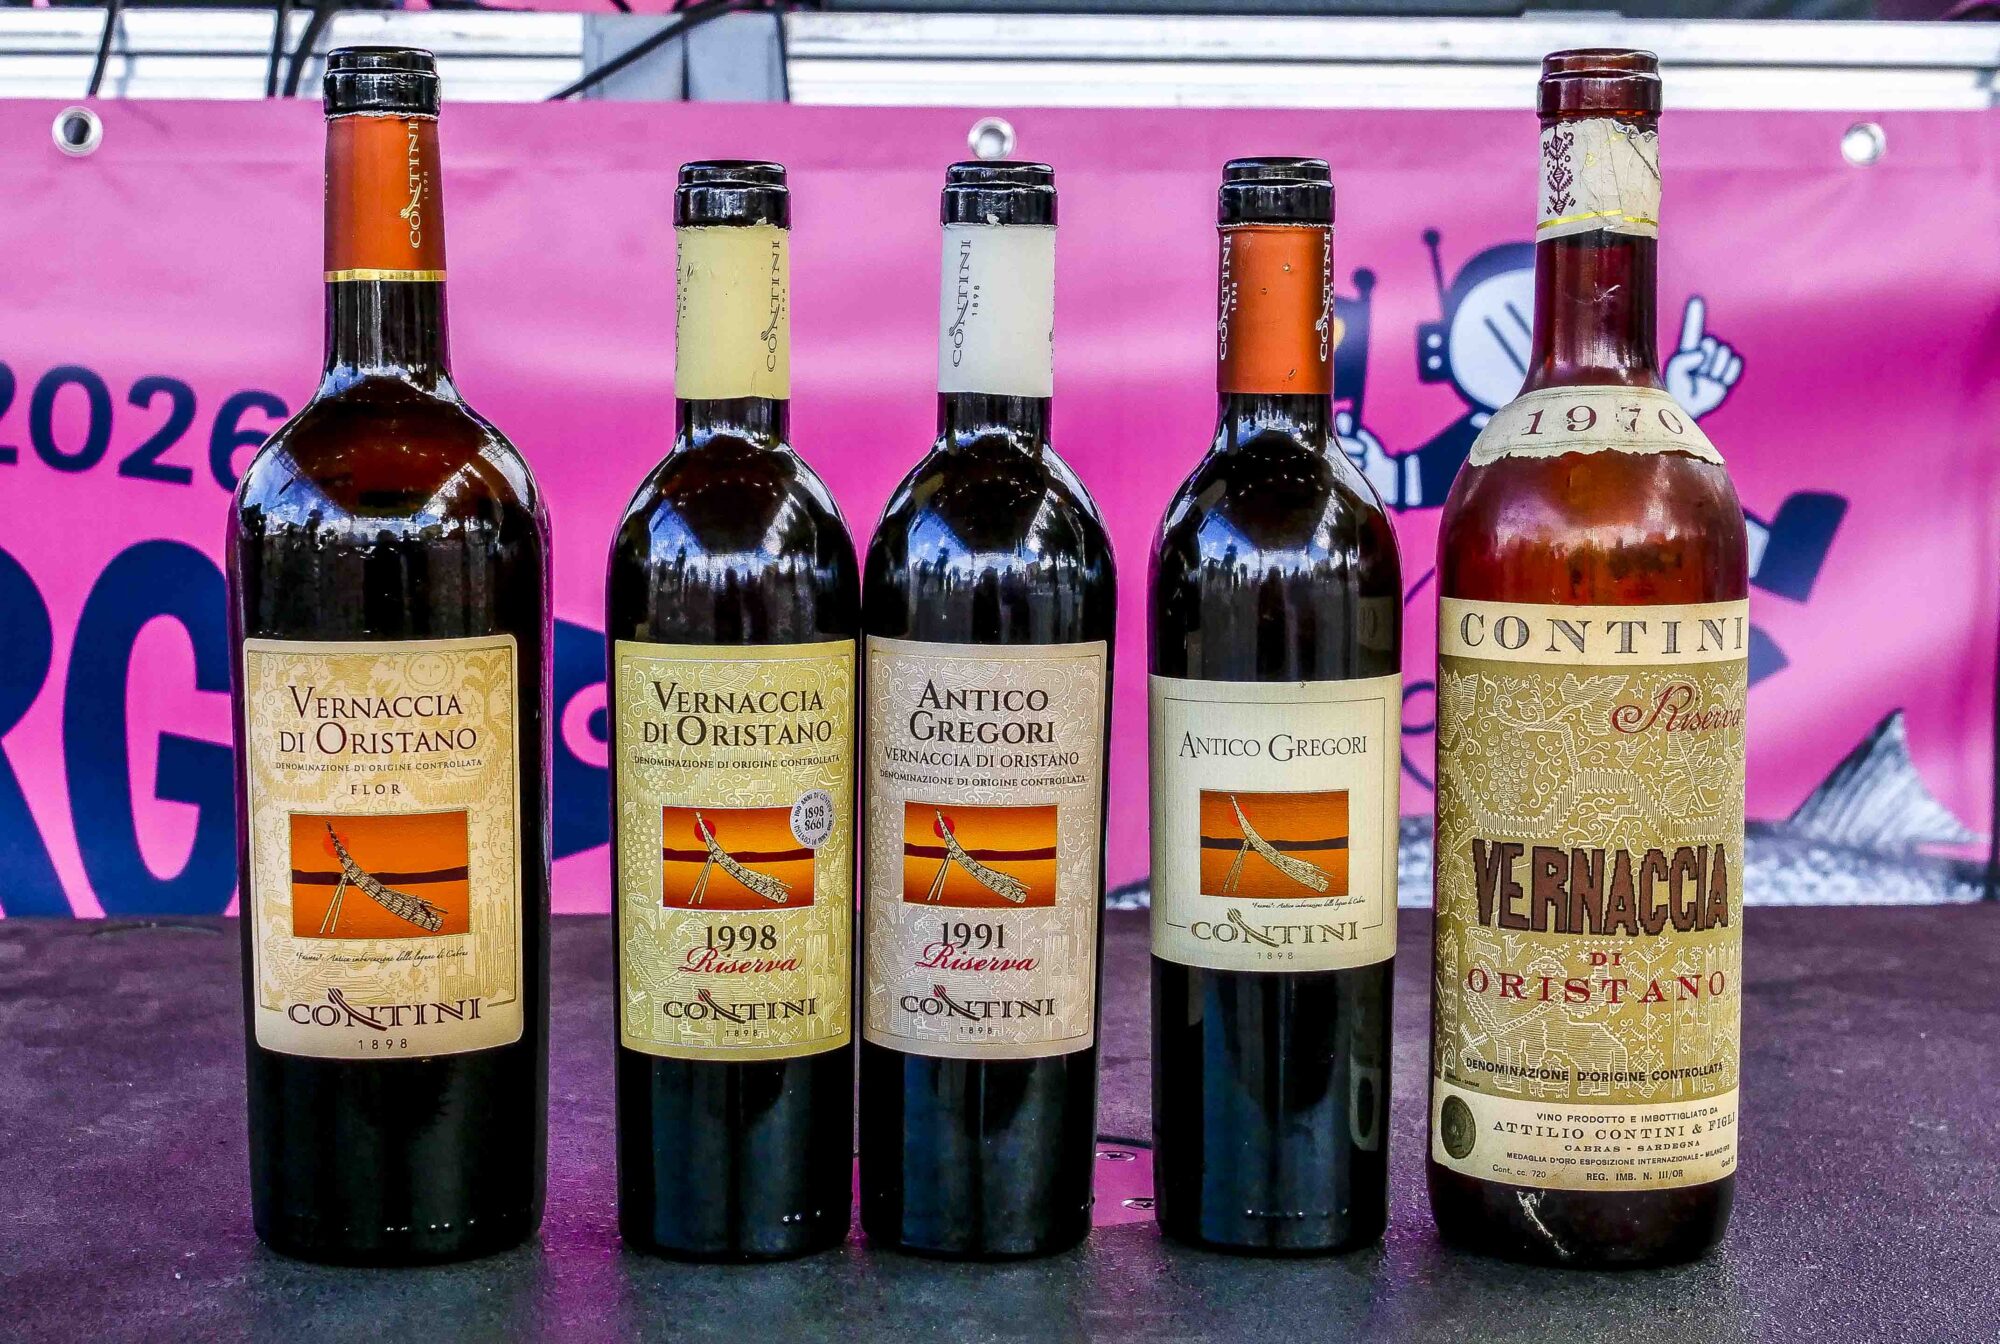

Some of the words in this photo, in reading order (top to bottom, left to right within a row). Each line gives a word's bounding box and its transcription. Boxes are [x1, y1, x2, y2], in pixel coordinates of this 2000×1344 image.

[400, 122, 421, 248] CONTINI
[761, 240, 780, 372] CONTINI
[949, 240, 971, 367] CONTINI
[971, 285, 980, 316] 1898
[1218, 235, 1232, 360] CONTINI
[1316, 232, 1331, 362] CONTINI
[0, 366, 290, 498] 026
[1521, 405, 1684, 436] 1970
[1460, 612, 1744, 654] CONTINI
[288, 685, 464, 719] VERNACCIA
[651, 681, 825, 714] VERNACCIA
[916, 678, 1049, 712] ANTICO
[1611, 685, 1741, 734] Riserva
[279, 731, 305, 753] DI
[316, 721, 477, 755] ORISTANO
[643, 721, 668, 744] DI
[677, 715, 832, 746] ORISTANO
[909, 710, 1056, 744] GREGORI
[634, 756, 714, 769] DENOMINAZIONE
[717, 761, 729, 769] DI
[732, 760, 778, 769] ORIGINE
[781, 754, 840, 767] CONTROLLATA
[884, 746, 971, 767] VERNACCIA
[976, 754, 994, 768] DI
[1000, 752, 1080, 768] ORISTANO
[1179, 730, 1261, 758] ANTICO
[1268, 733, 1367, 762] GREGORI
[276, 762, 350, 772] DENOMINAZIONE
[354, 764, 365, 772] DI
[369, 763, 412, 772] ORIGINE
[416, 758, 482, 770] CONTROLLATA
[880, 769, 954, 785] DENOMINAZIONE
[957, 777, 969, 786] DI
[972, 777, 1018, 787] ORIGINE
[1021, 774, 1086, 786] CONTROLLATA
[351, 784, 401, 795] FLOR
[805, 805, 824, 819] 1898
[1472, 838, 1729, 936] VERNACCIA
[705, 924, 777, 951] 1998
[941, 921, 1006, 950] 1991
[1191, 907, 1358, 948] CONTINI
[677, 944, 803, 974] Riserva
[915, 941, 1040, 971] Riserva
[1257, 951, 1294, 961] 1898
[1589, 951, 1621, 967] DI
[1467, 968, 1726, 1005] ORISTANO
[288, 987, 481, 1031] CONTINI
[662, 988, 818, 1024] CONTINI
[900, 984, 1056, 1021] CONTINI
[358, 1038, 408, 1050] 1898
[725, 1029, 759, 1037] 1898
[960, 1026, 993, 1034] 1898
[1466, 1057, 1570, 1081] DENOMINAZIONE
[1577, 1070, 1646, 1082] D'ORIGINE
[1651, 1061, 1723, 1081] CONTROLLATA
[1493, 1120, 1584, 1140] ATTILIO
[1595, 1125, 1685, 1140] CONTINI
[1692, 1123, 1702, 1135] &
[1708, 1111, 1736, 1132] FIGLI
[1536, 1112, 1562, 1122] VINO
[1567, 1114, 1625, 1124] PRODOTTO
[1630, 1115, 1637, 1123] E
[1641, 1109, 1708, 1123] IMBOTTIGLIATO
[1709, 1106, 1718, 1115] DA
[1506, 1151, 1547, 1163] MEDAGLIA
[1550, 1157, 1577, 1165] D'ORO
[1580, 1158, 1635, 1166] ESPOSIZIONE
[1638, 1153, 1698, 1165] INTERNAZIONALE
[1564, 1144, 1621, 1153] CABRAS
[1637, 1140, 1700, 1152] SARDEGNA
[1492, 1164, 1513, 1175] Cont.
[1516, 1169, 1528, 1177] cc.
[1532, 1170, 1547, 1179] 720
[1586, 1172, 1609, 1181] REG.
[1615, 1172, 1637, 1181] IMB.
[1643, 1172, 1653, 1181] N.
[1658, 1169, 1684, 1180] III/OR
